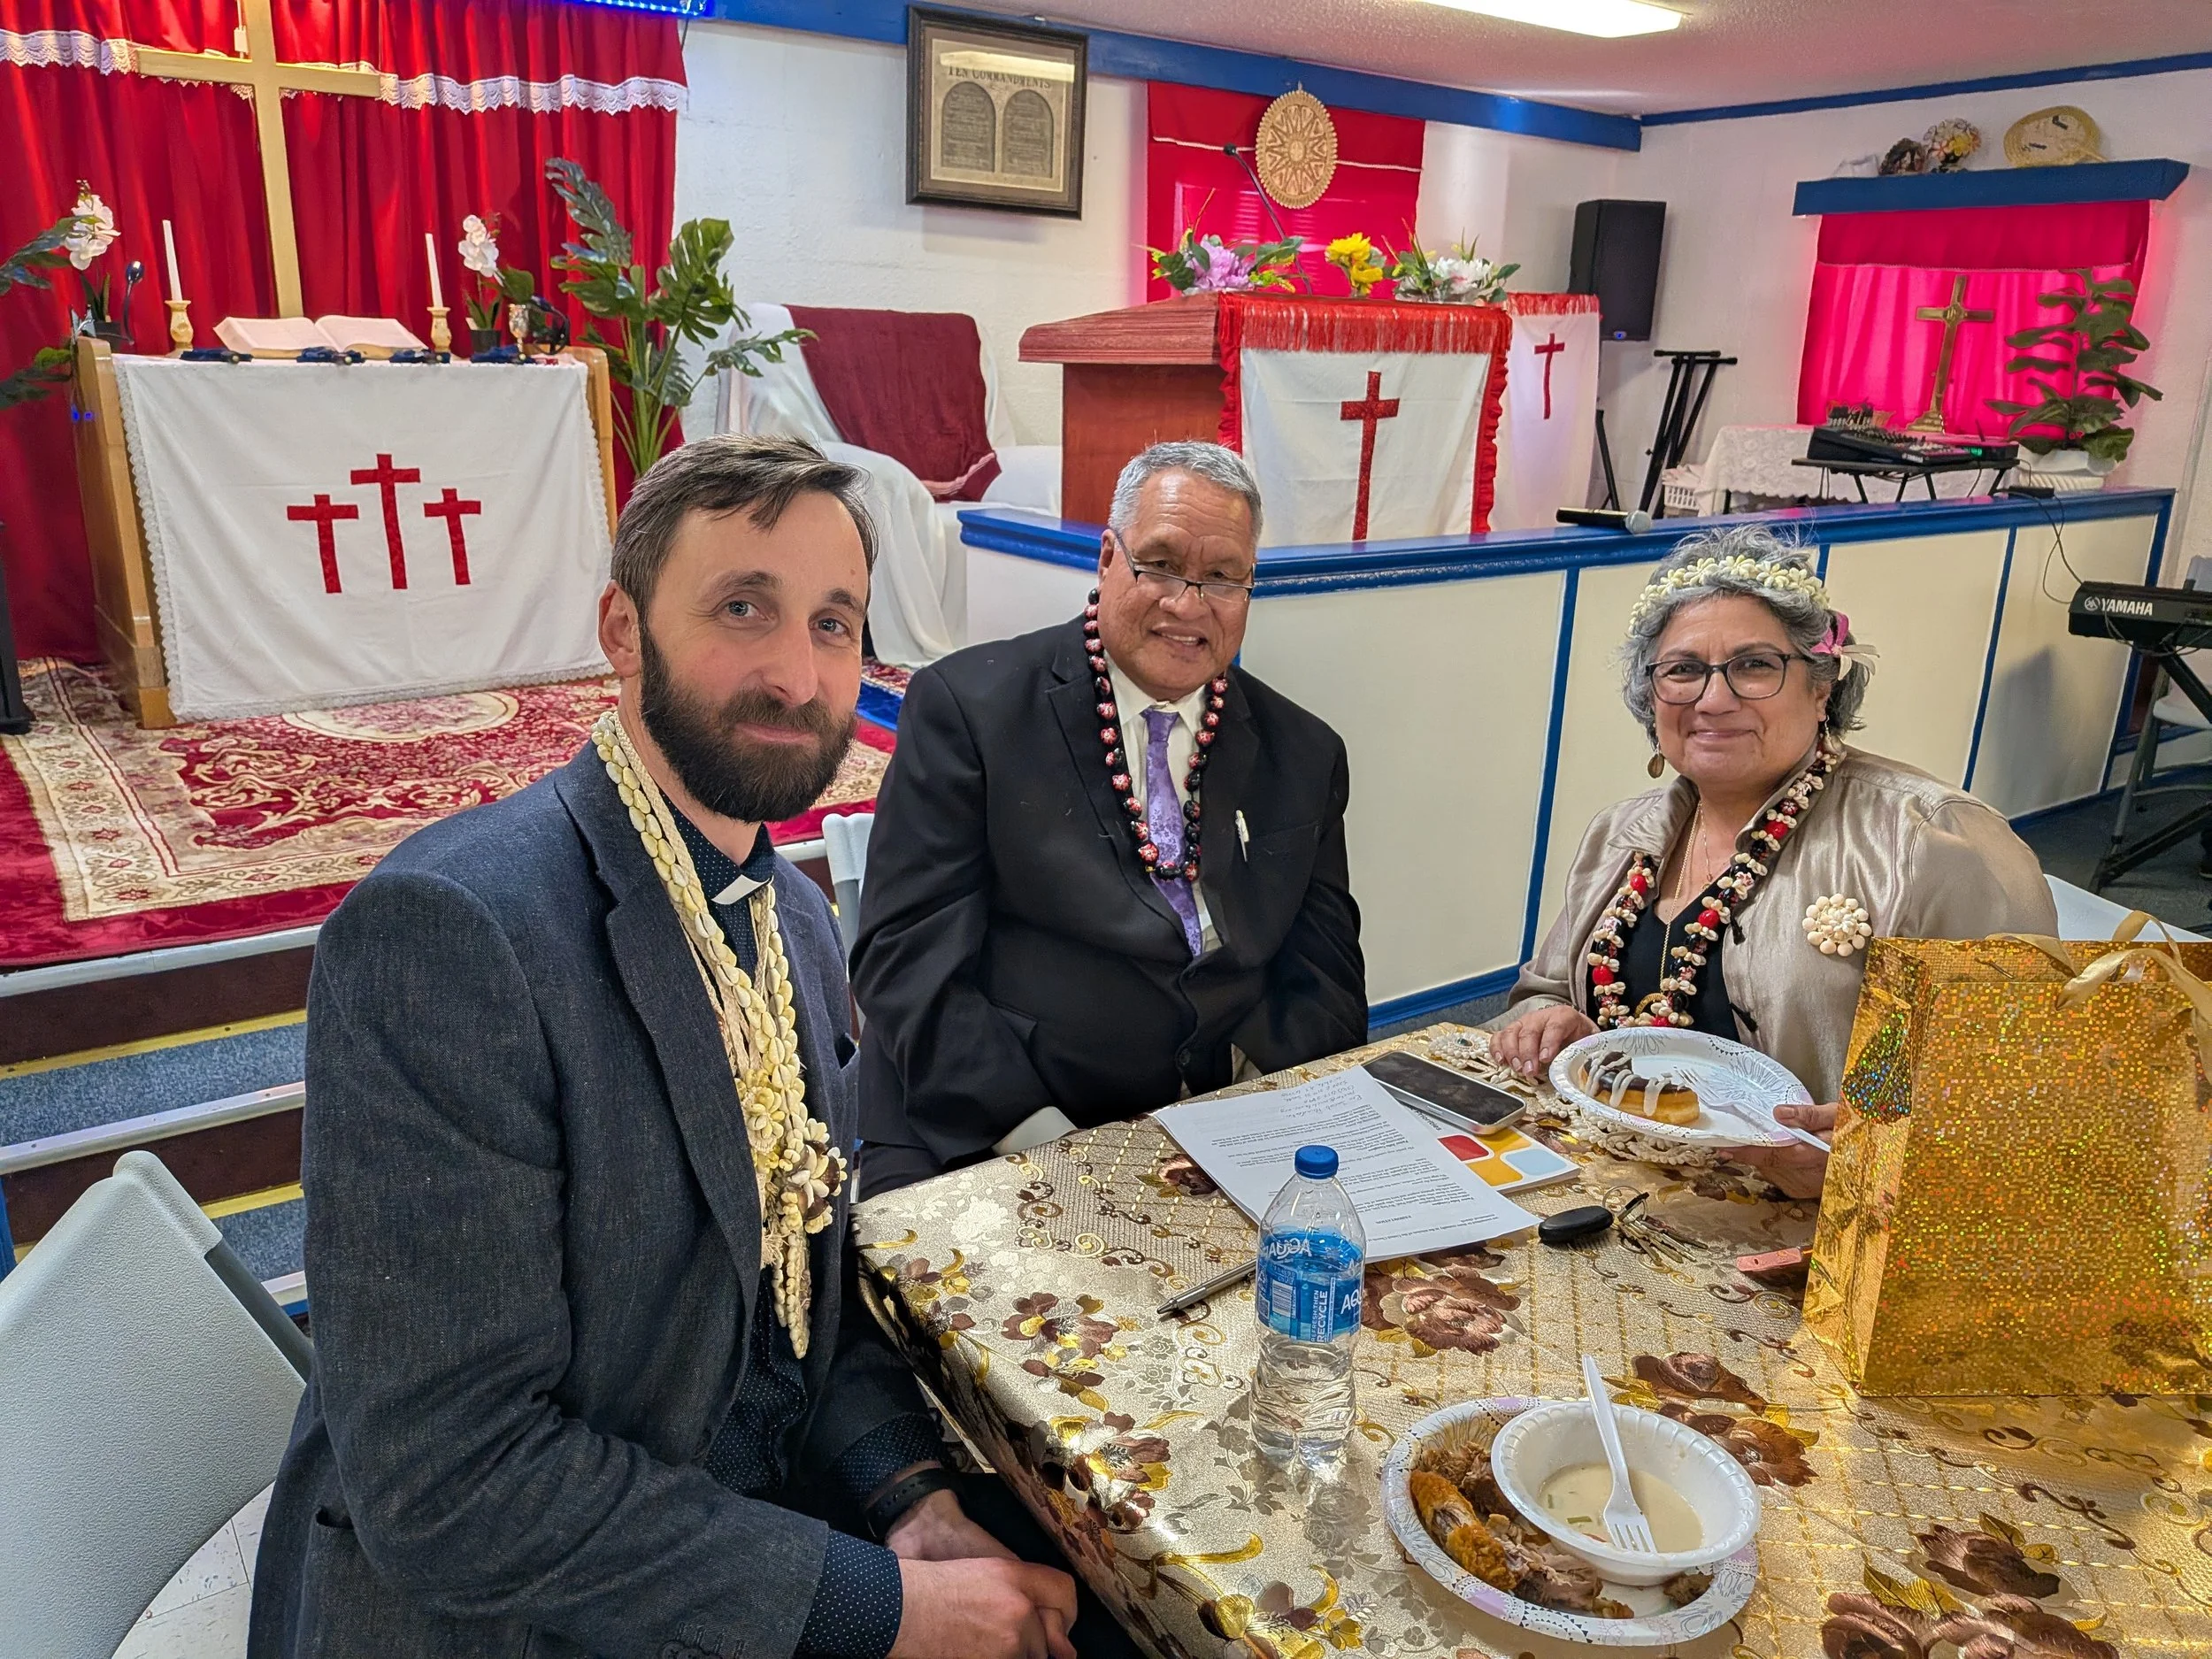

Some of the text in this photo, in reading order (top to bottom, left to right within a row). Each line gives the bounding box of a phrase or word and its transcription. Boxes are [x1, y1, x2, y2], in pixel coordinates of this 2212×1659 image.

[949, 65, 1051, 88] TEN COMMANDMENTS
[2101, 597, 2153, 616] YAMAHA
[1340, 1288, 1361, 1315] AQ
[1317, 1290, 1328, 1343] RECYCLE
